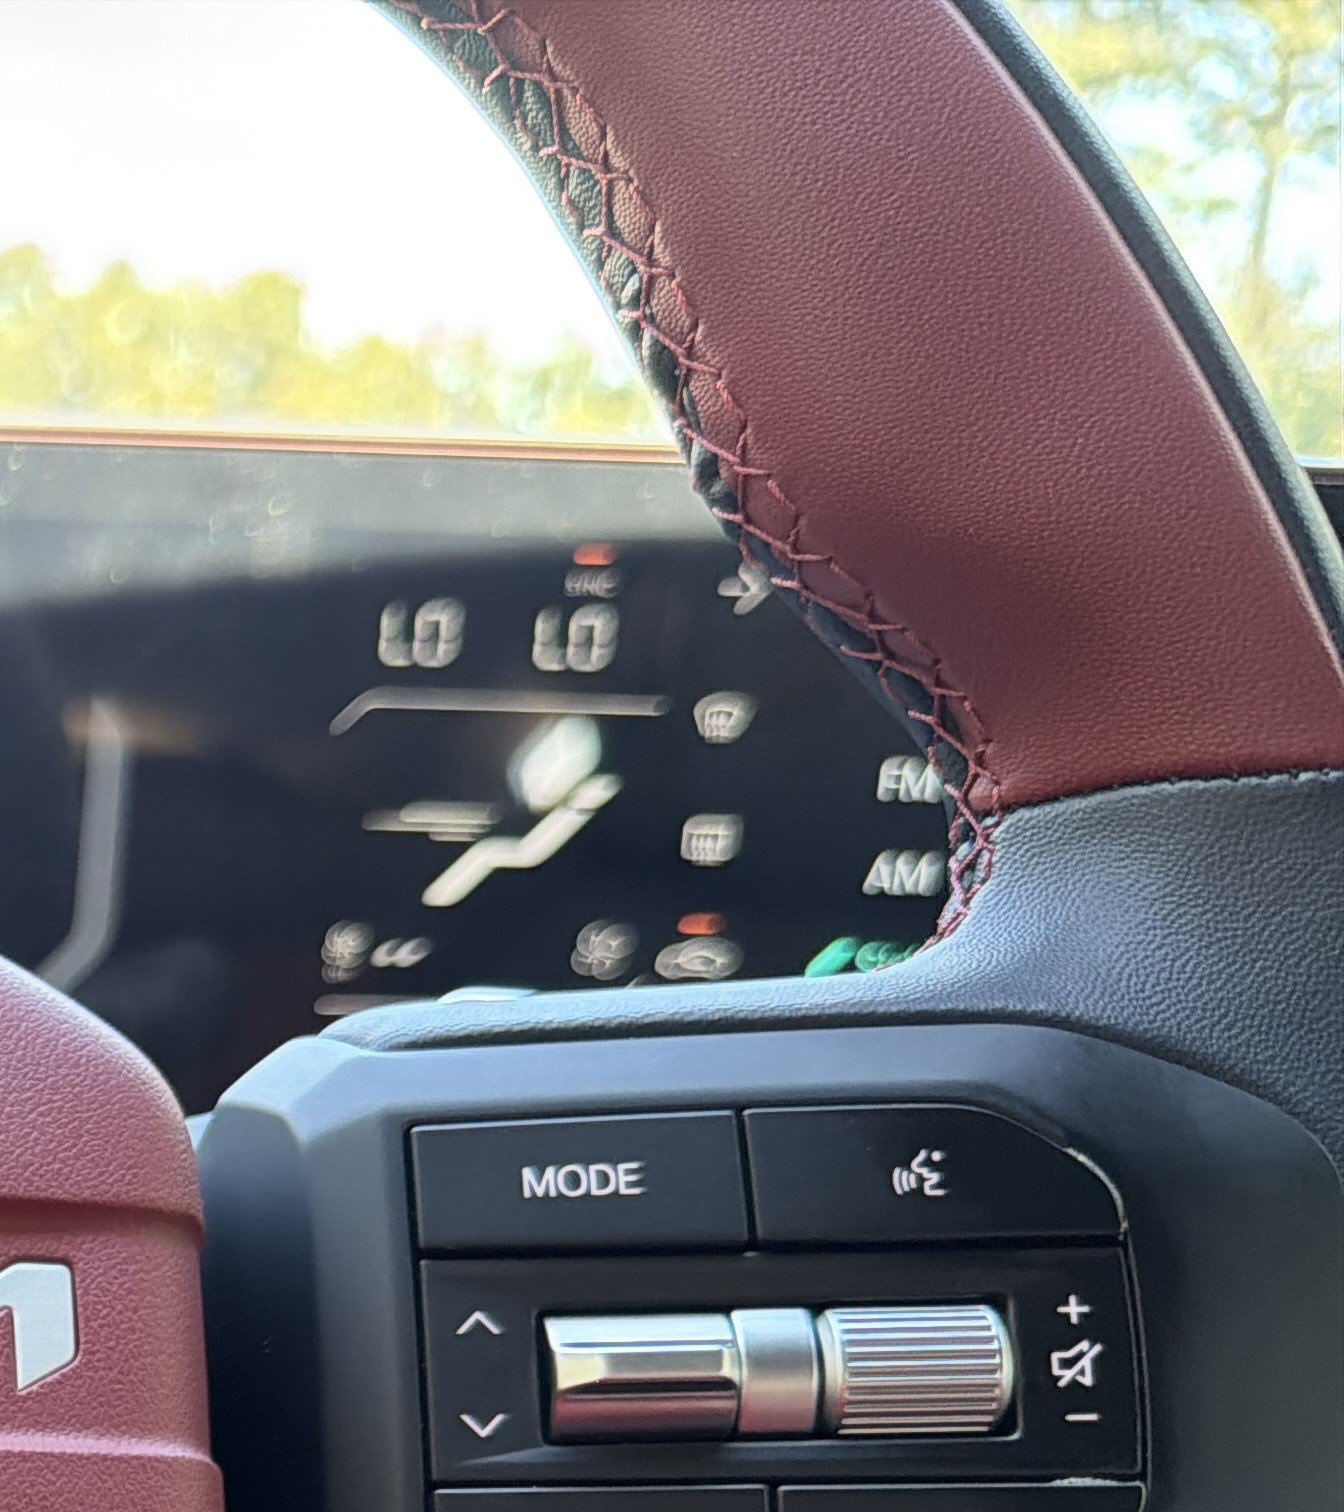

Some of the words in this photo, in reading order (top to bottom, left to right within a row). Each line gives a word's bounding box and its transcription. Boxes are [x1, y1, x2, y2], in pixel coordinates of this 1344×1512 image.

[877, 755, 947, 804] FM
[862, 849, 949, 897] AM
[521, 1161, 648, 1199] MODE
